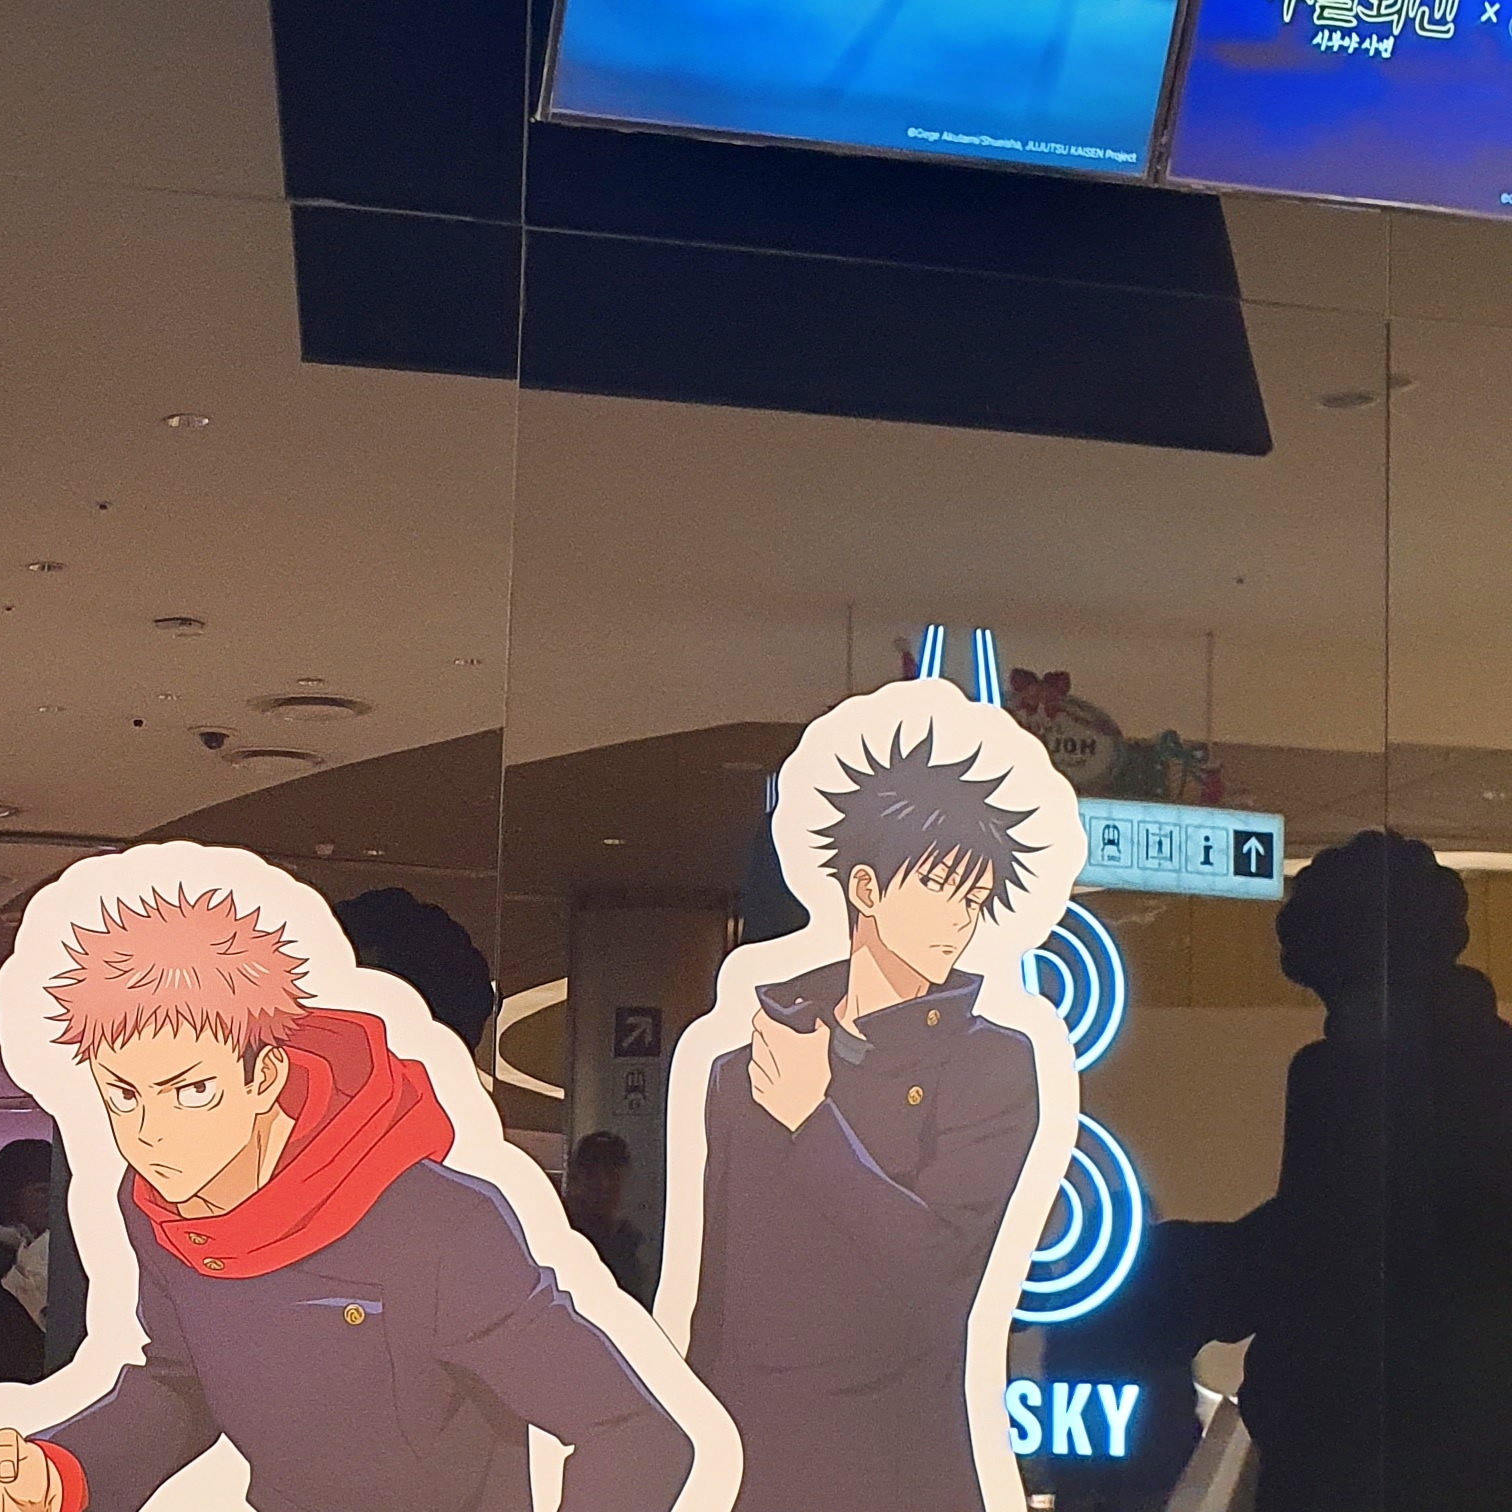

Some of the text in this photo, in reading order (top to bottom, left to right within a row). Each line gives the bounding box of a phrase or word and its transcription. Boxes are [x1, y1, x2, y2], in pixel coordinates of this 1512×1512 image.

[1025, 141, 1070, 156] JUJUTSU
[1070, 145, 1104, 159] KAISEN
[1105, 149, 1137, 163] Project
[1005, 1379, 1140, 1457] SKY
